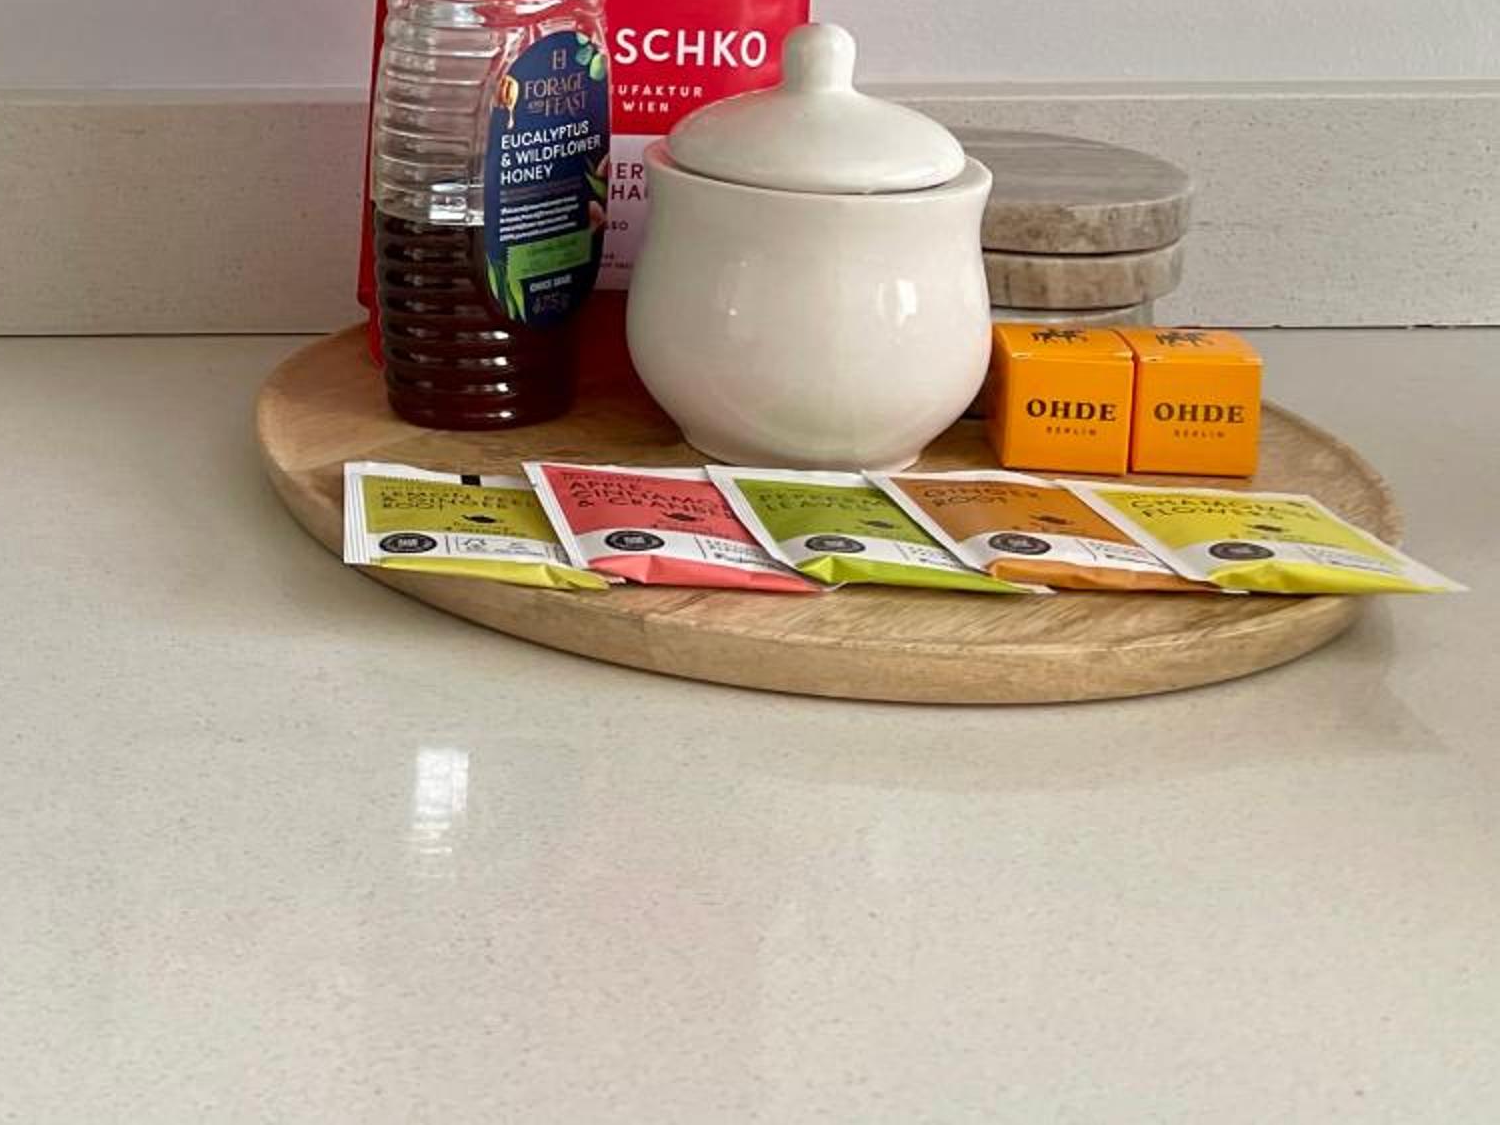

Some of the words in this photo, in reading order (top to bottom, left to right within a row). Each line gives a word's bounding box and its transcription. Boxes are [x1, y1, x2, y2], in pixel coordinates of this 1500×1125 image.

[614, 28, 767, 67] SCHKO
[612, 84, 704, 98] UFAKTUR
[622, 101, 670, 113] WIEN
[501, 120, 589, 150] EUCALYPTUS
[500, 153, 512, 168] &
[515, 134, 601, 165] WILDFLOWER
[500, 164, 553, 186] HONEY
[1026, 398, 1118, 422] OHDE
[1153, 402, 1246, 424] OHDE
